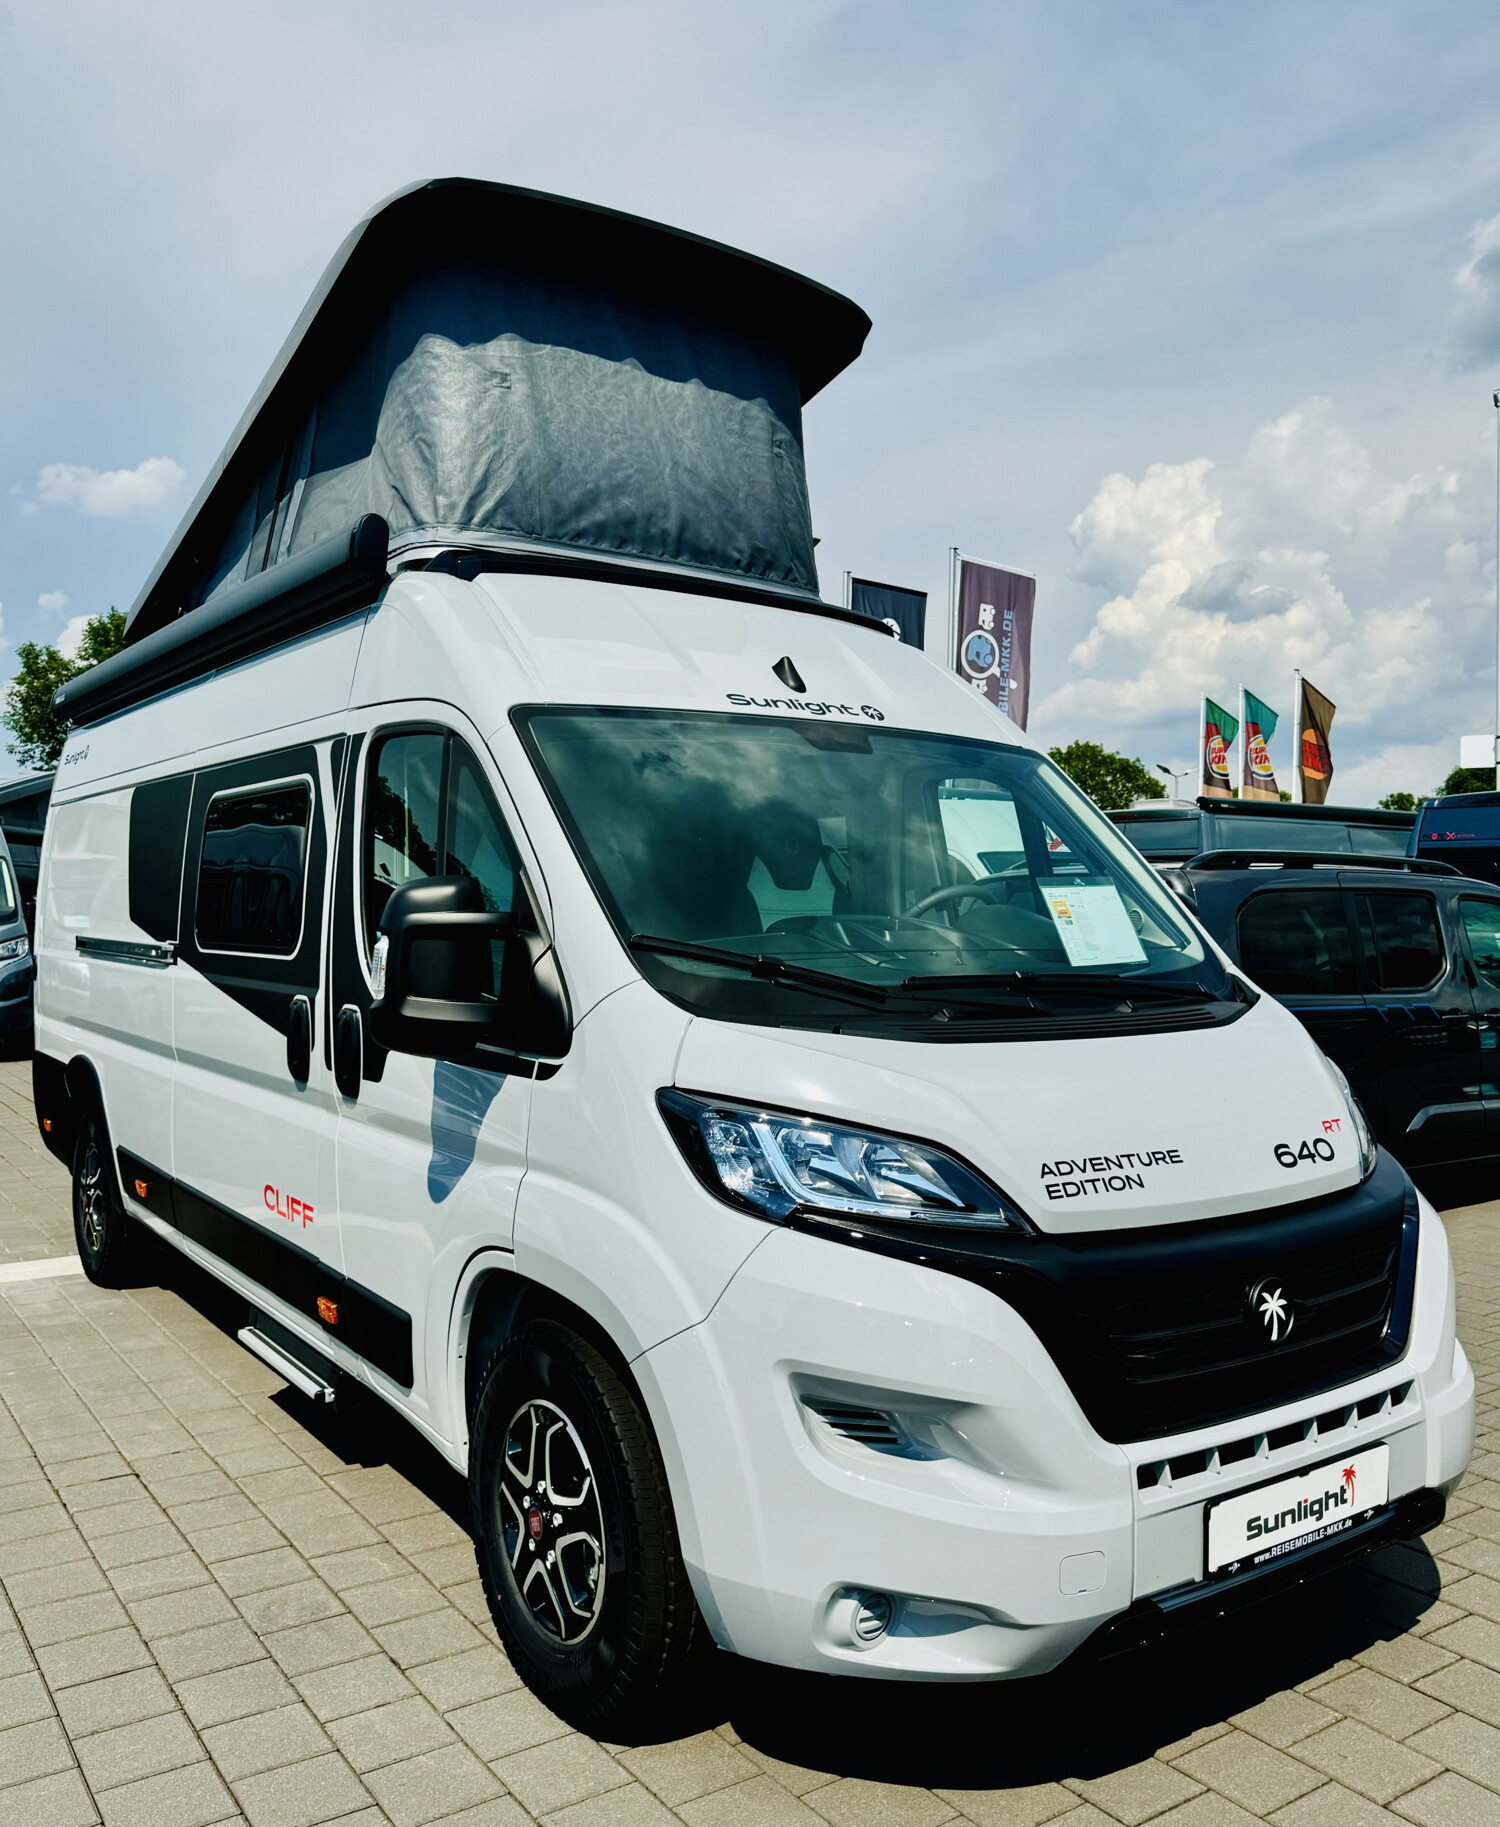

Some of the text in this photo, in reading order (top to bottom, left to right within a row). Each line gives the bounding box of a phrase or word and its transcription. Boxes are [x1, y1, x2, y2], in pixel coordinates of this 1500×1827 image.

[726, 694, 860, 716] Sunlight
[1321, 1118, 1341, 1134] RT
[1040, 1149, 1184, 1179] ADVENTURE
[1273, 1137, 1335, 1169] 640
[1045, 1174, 1145, 1200] EDITION
[264, 1184, 314, 1229] CLIFF
[1246, 1484, 1348, 1541] Sunlight
[1254, 1519, 1353, 1564] www.REISEMOBILE-MKK.de
